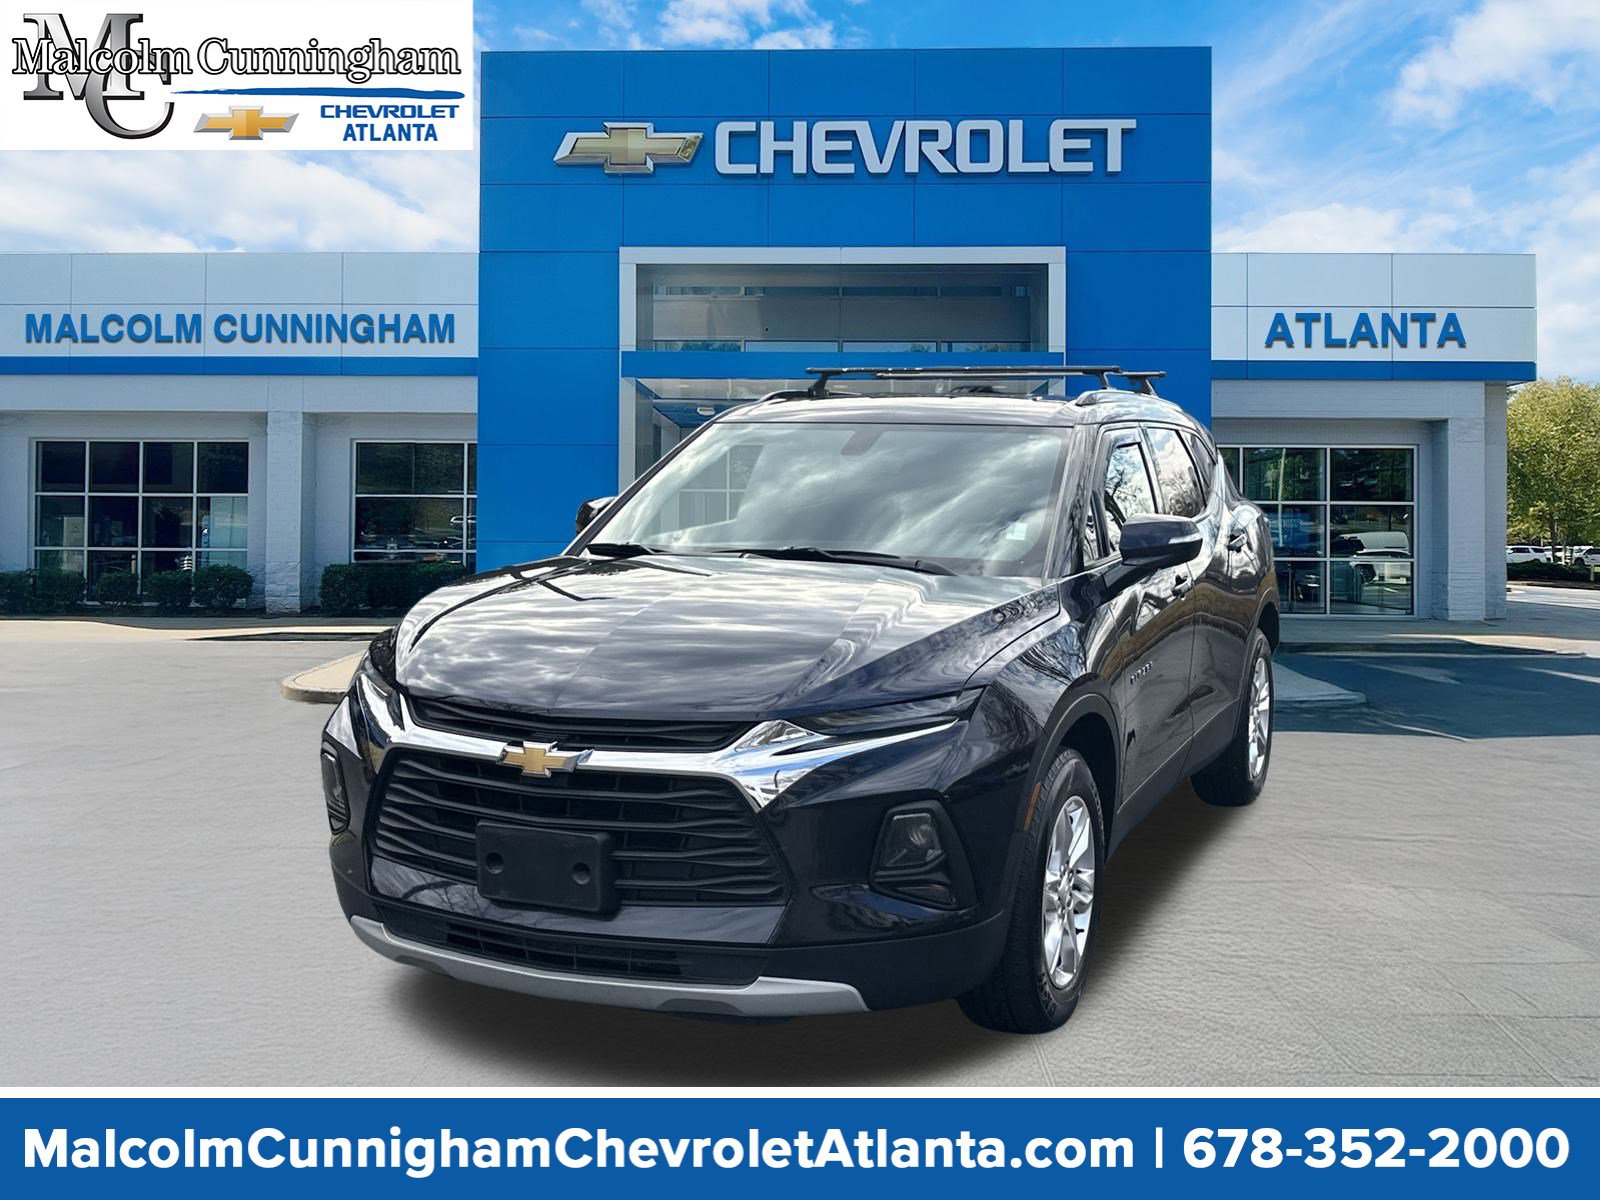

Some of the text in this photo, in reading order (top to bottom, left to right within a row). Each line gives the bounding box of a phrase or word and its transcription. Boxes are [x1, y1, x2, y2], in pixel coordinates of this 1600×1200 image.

[715, 118, 1137, 175] CHEVROLET
[25, 313, 455, 343] MALCOLM CUNNINGHAM
[1264, 312, 1467, 349] ATLANTA
